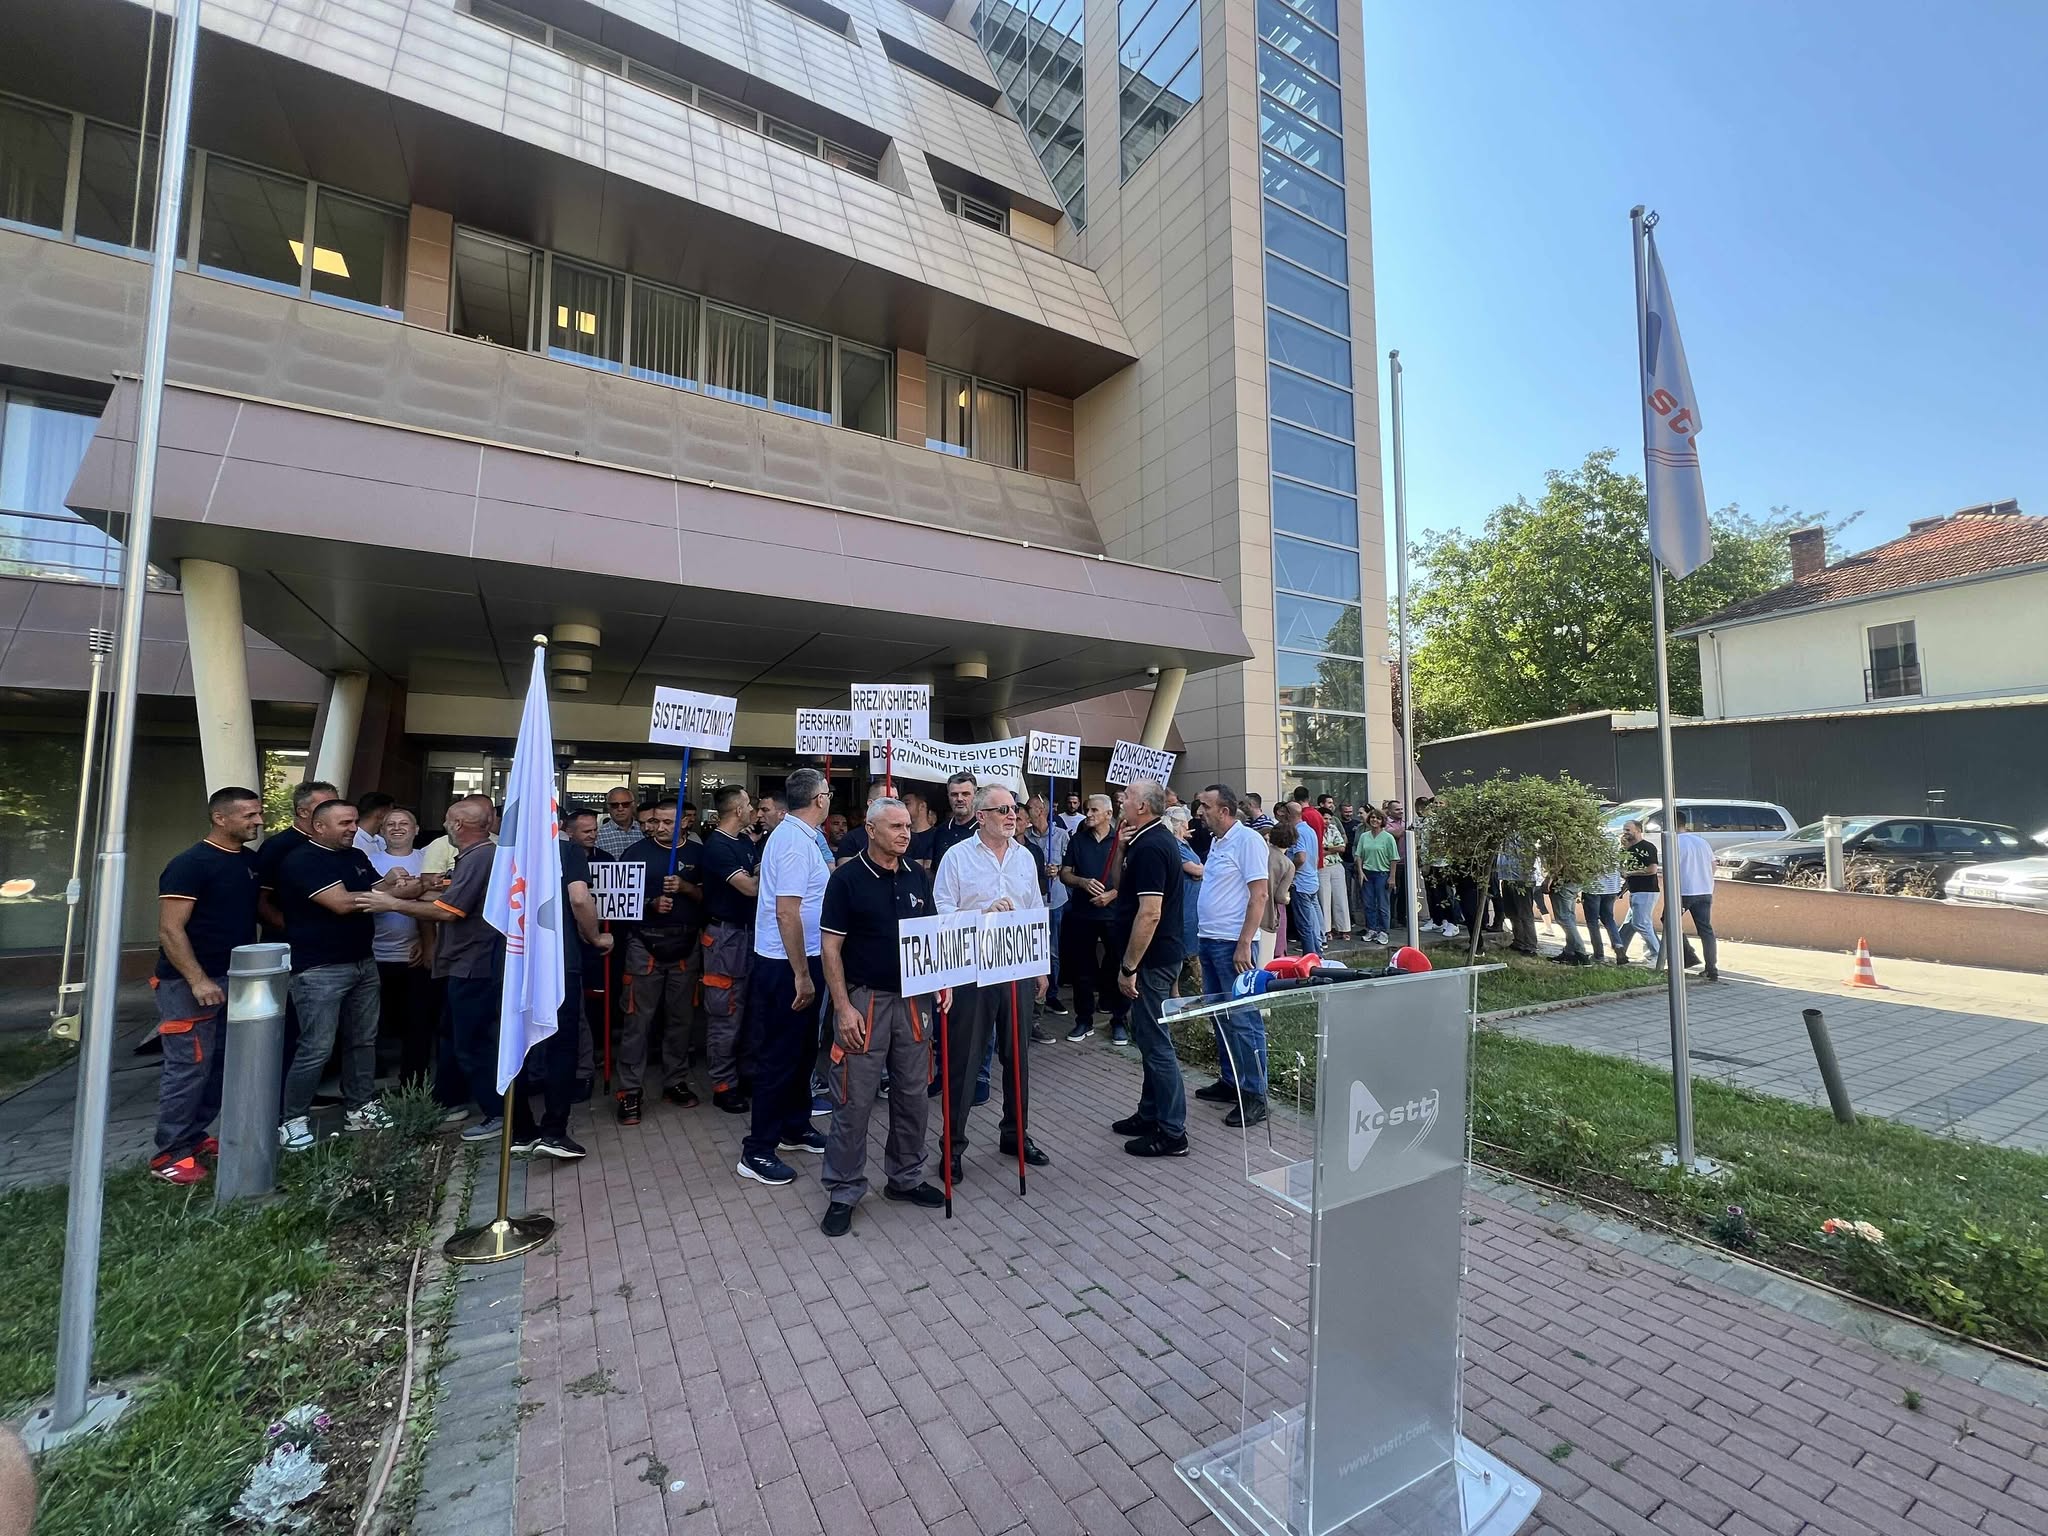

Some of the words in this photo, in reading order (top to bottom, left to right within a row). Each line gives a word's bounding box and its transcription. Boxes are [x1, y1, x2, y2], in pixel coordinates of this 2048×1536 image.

[853, 686, 928, 711] RREZIKSHMËRIA
[870, 713, 882, 739] NË
[885, 713, 912, 739] PUNË!
[797, 735, 822, 752] VENDIT
[825, 732, 833, 753] TË
[1000, 746, 1024, 759] DHE
[1032, 735, 1065, 755] ORËT
[1068, 741, 1077, 756] E
[963, 764, 981, 774] NË
[1113, 742, 1167, 771] KONKURSET
[1165, 755, 1174, 773] E
[591, 864, 645, 889] HTIMET
[590, 893, 640, 918] TARE!
[978, 922, 1049, 971] KOMISIONET!
[1354, 1096, 1436, 1135] kostt
